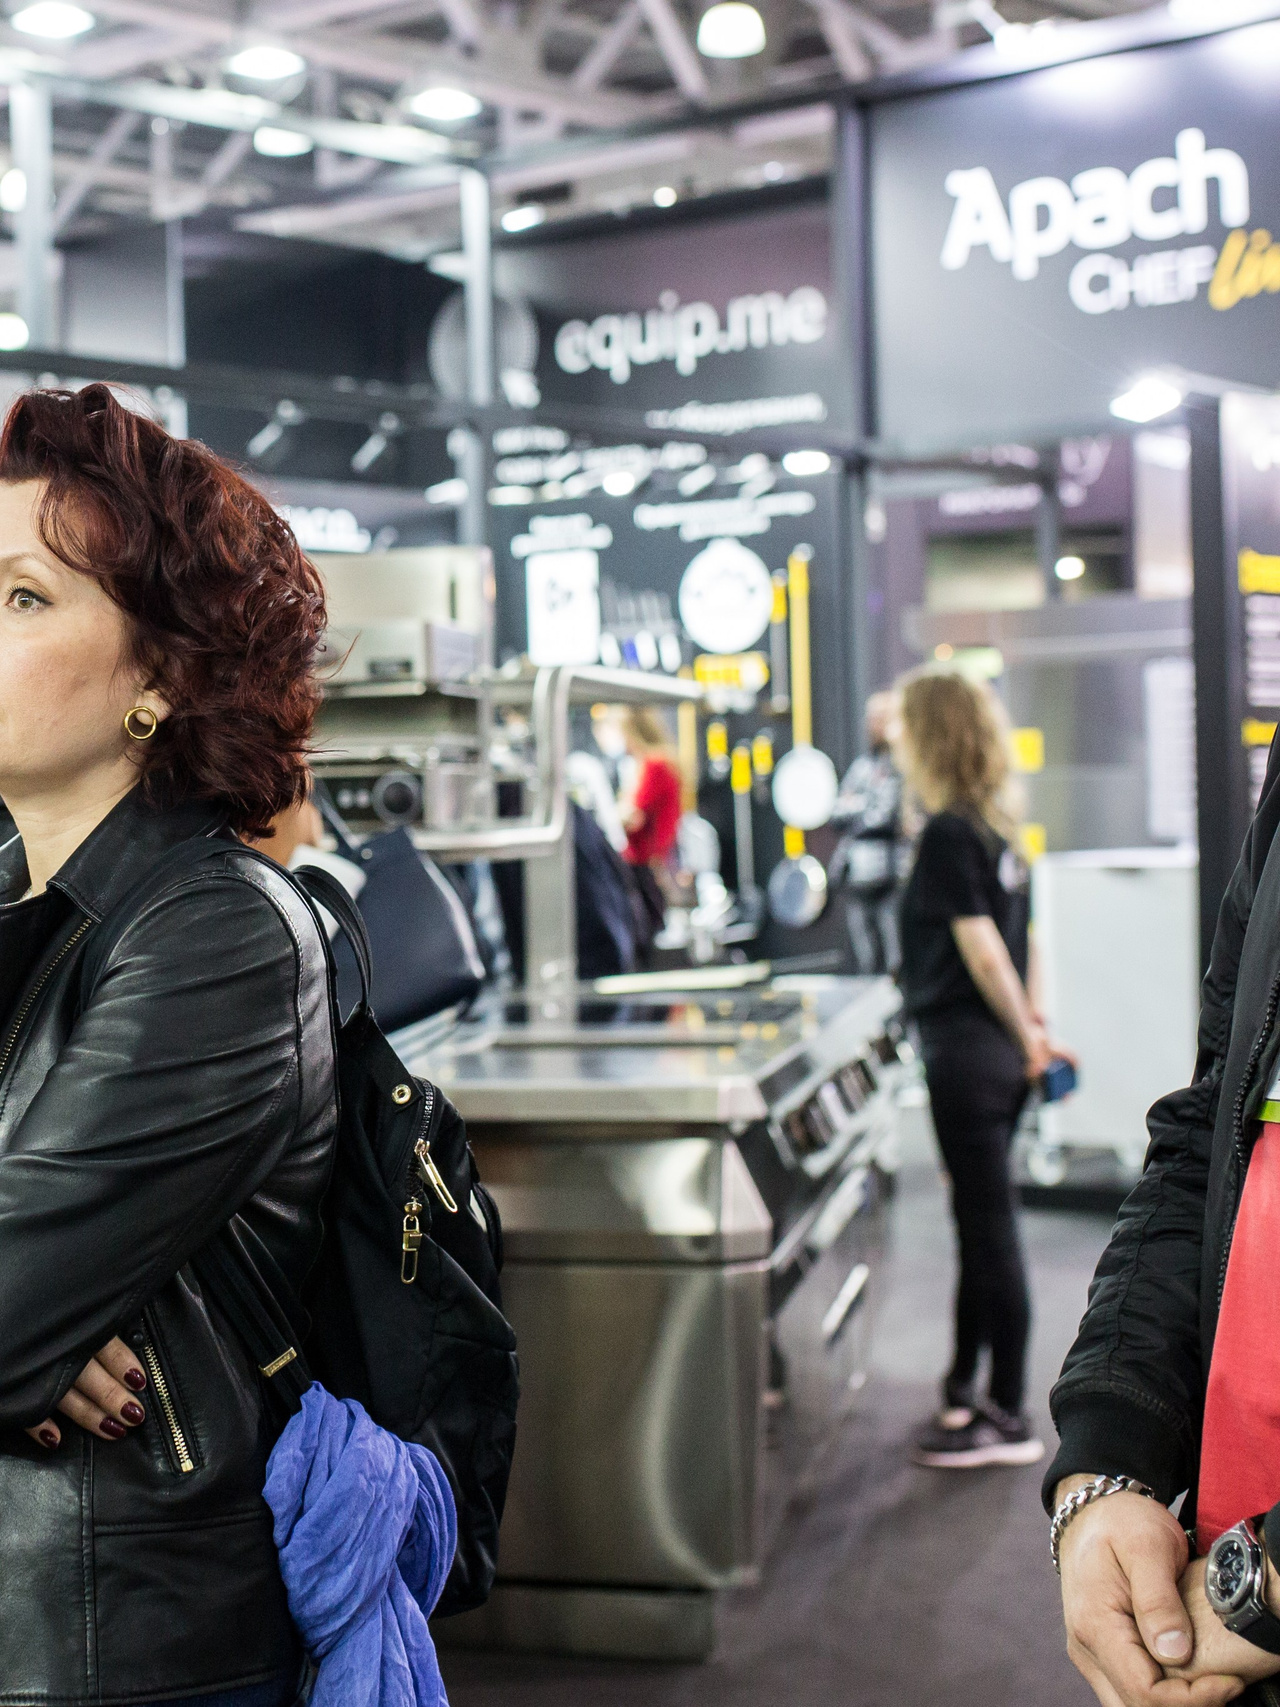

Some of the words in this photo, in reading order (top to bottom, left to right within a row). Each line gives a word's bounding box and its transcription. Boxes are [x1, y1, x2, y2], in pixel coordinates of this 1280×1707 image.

[941, 128, 1250, 281] Apach
[1068, 244, 1218, 314] CHEF
[554, 286, 826, 384] equip.me
